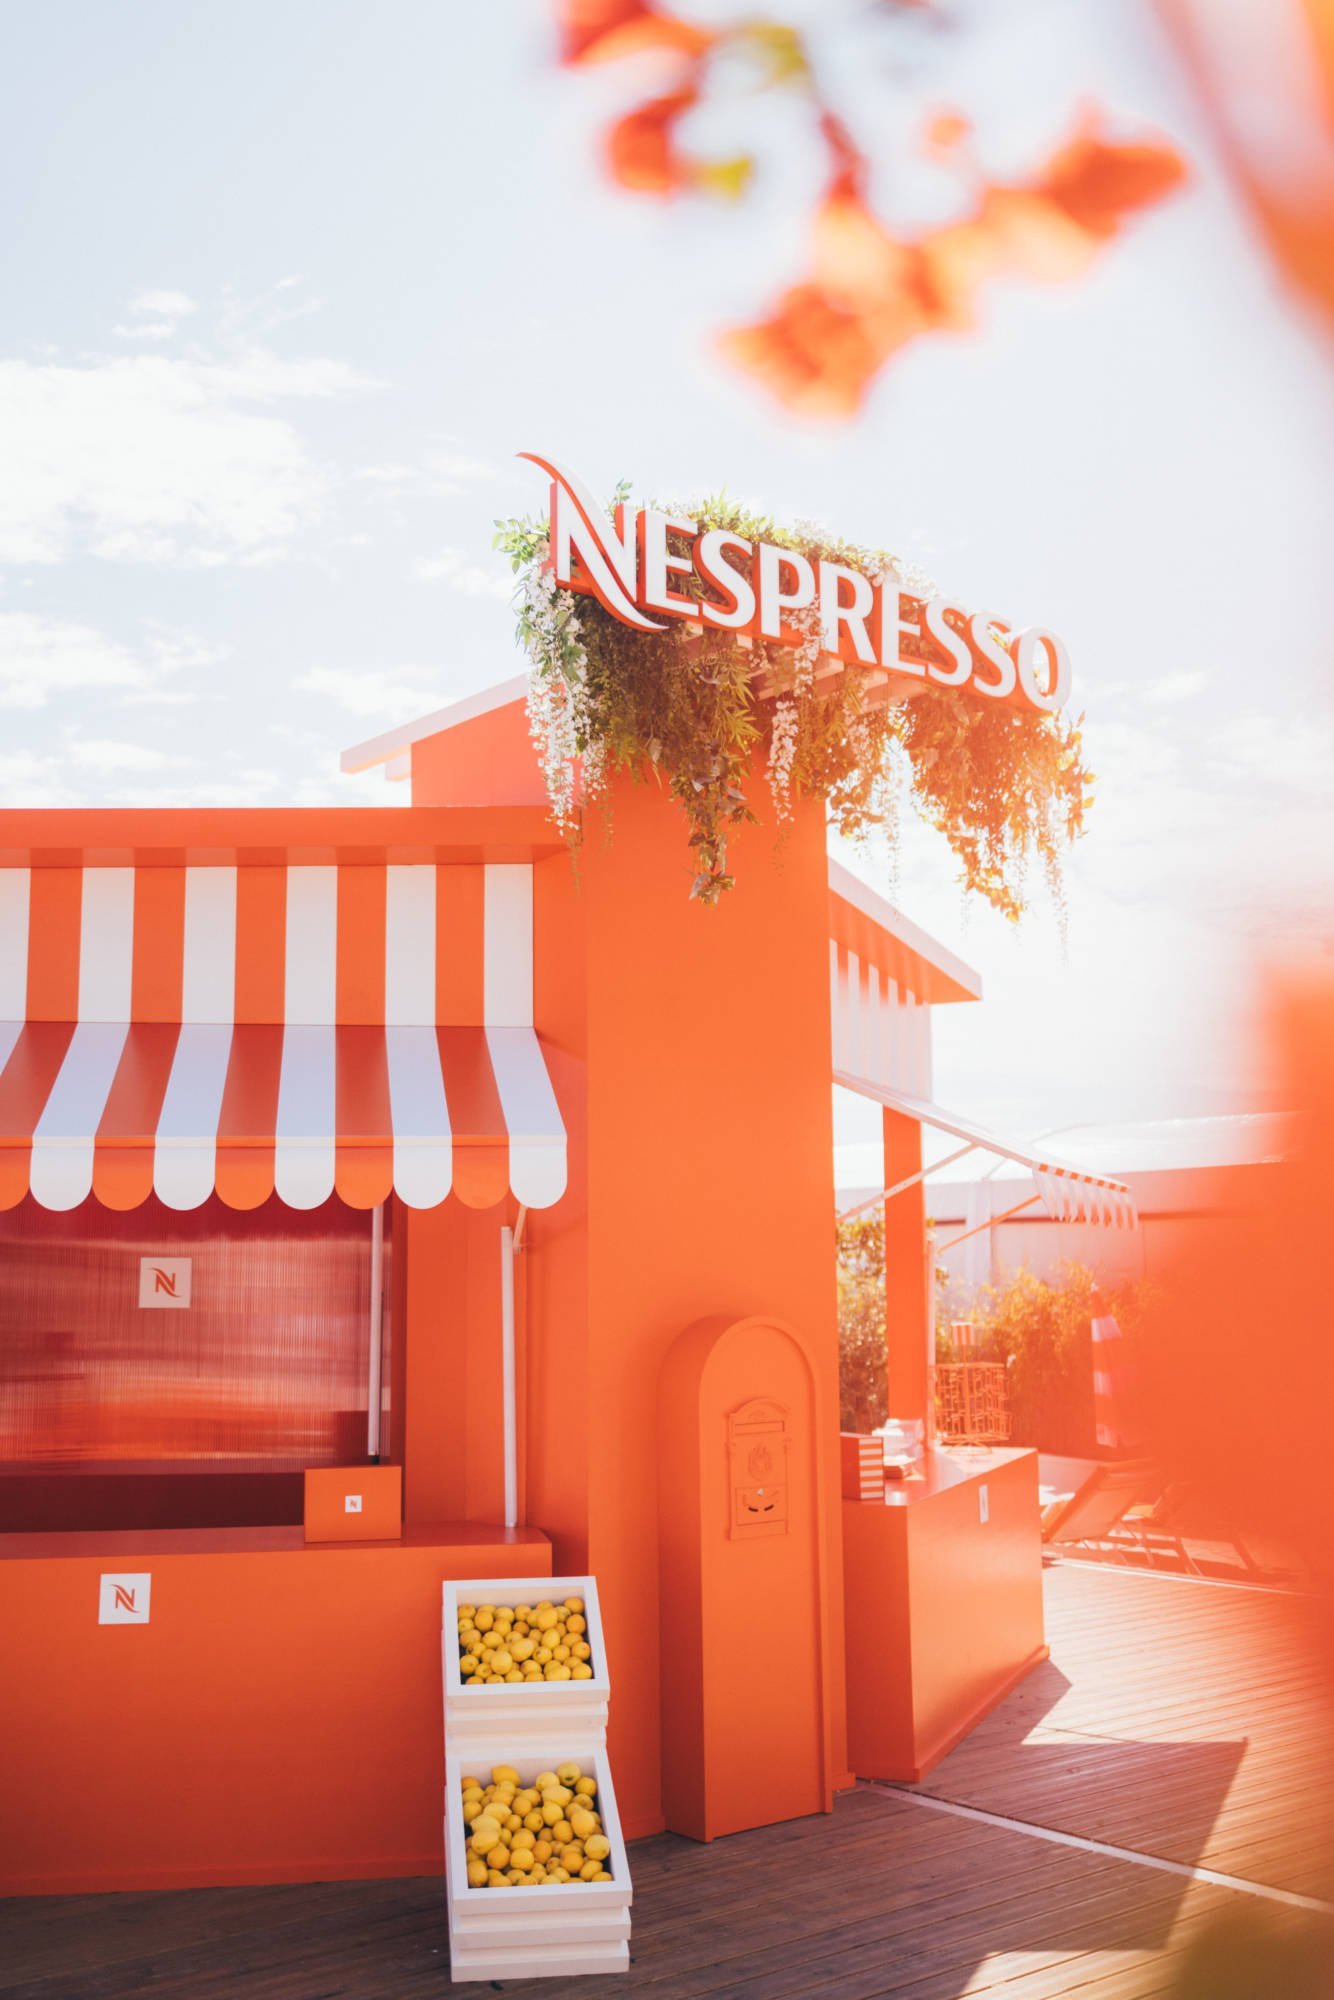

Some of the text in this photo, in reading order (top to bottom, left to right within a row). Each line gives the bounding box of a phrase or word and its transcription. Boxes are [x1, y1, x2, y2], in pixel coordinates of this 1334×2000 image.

[515, 451, 1072, 711] NESPRESSO
[147, 1267, 182, 1298] N
[109, 1584, 140, 1613] N
